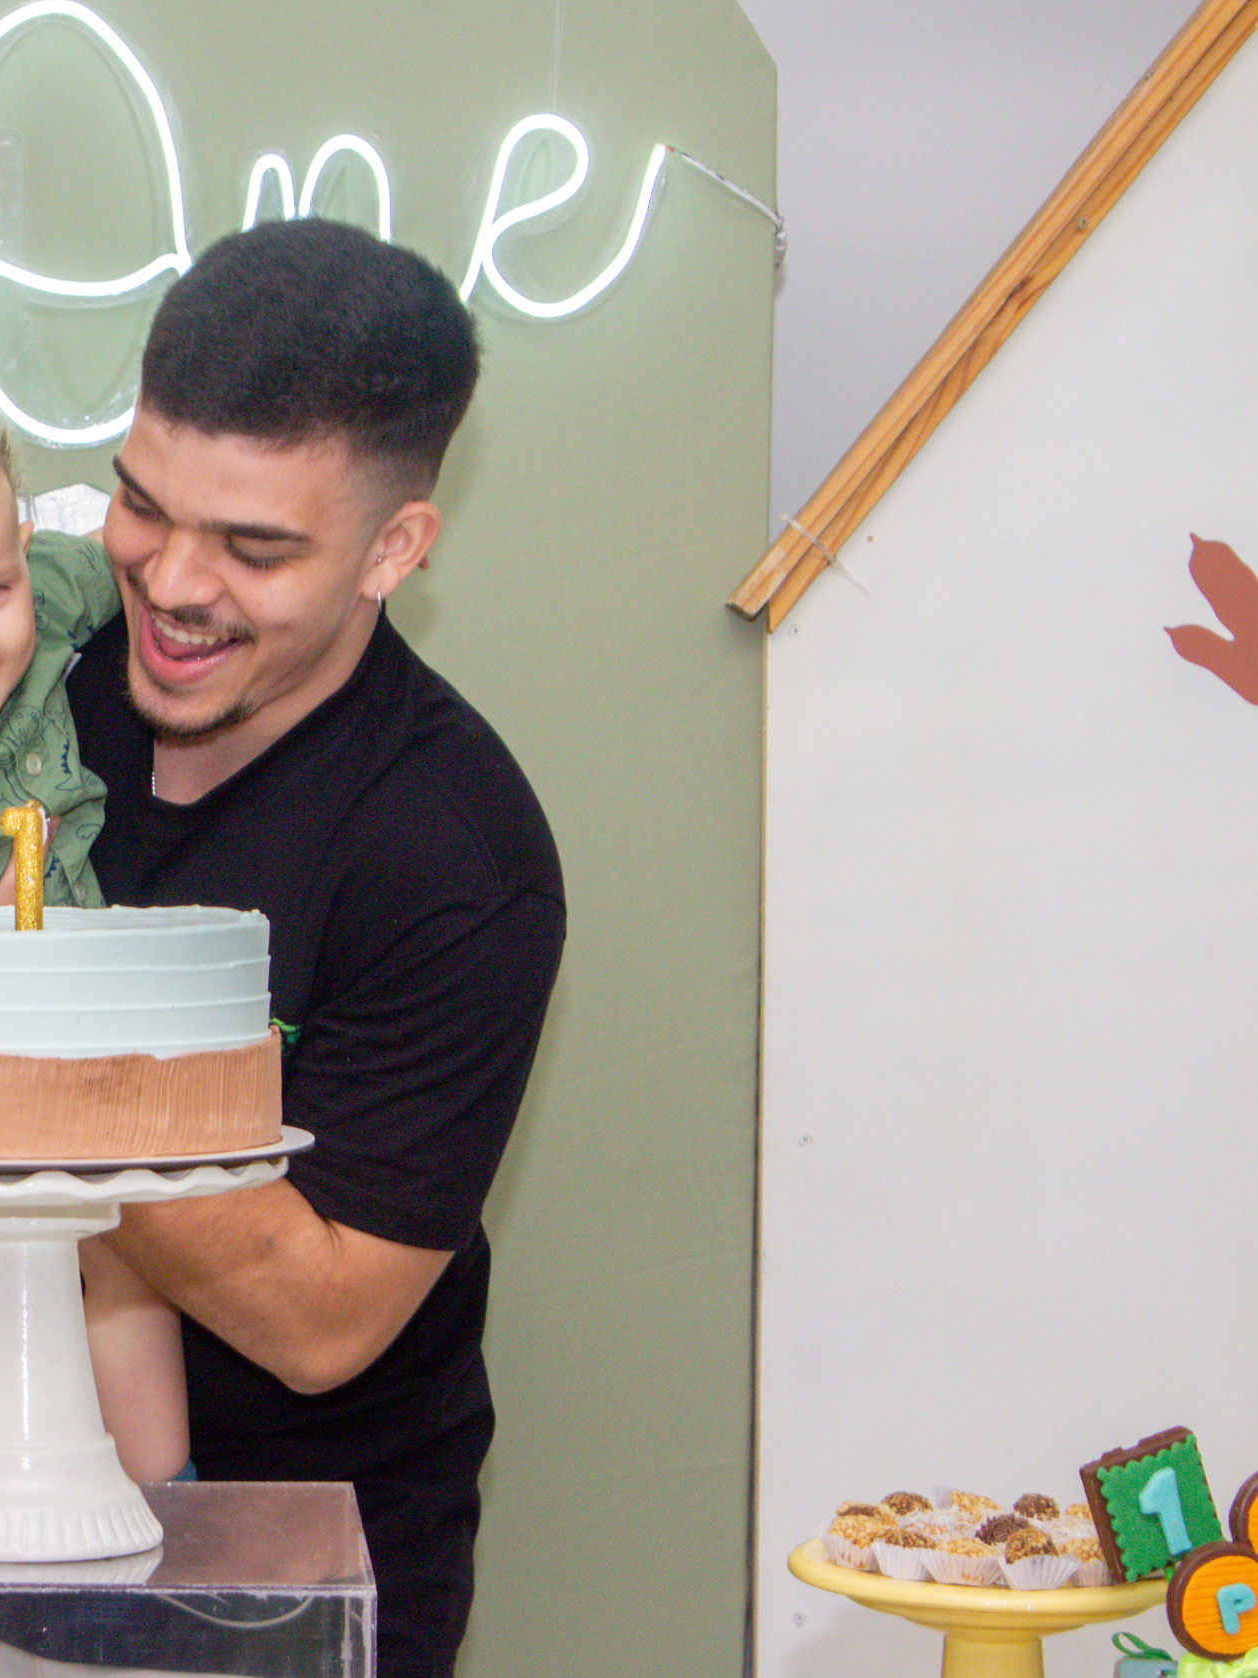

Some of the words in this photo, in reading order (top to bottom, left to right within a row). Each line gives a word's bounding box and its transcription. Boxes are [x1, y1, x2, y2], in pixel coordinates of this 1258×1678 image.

[0, 800, 44, 931] 1
[1139, 1466, 1192, 1556] 1
[1216, 1582, 1256, 1635] P
